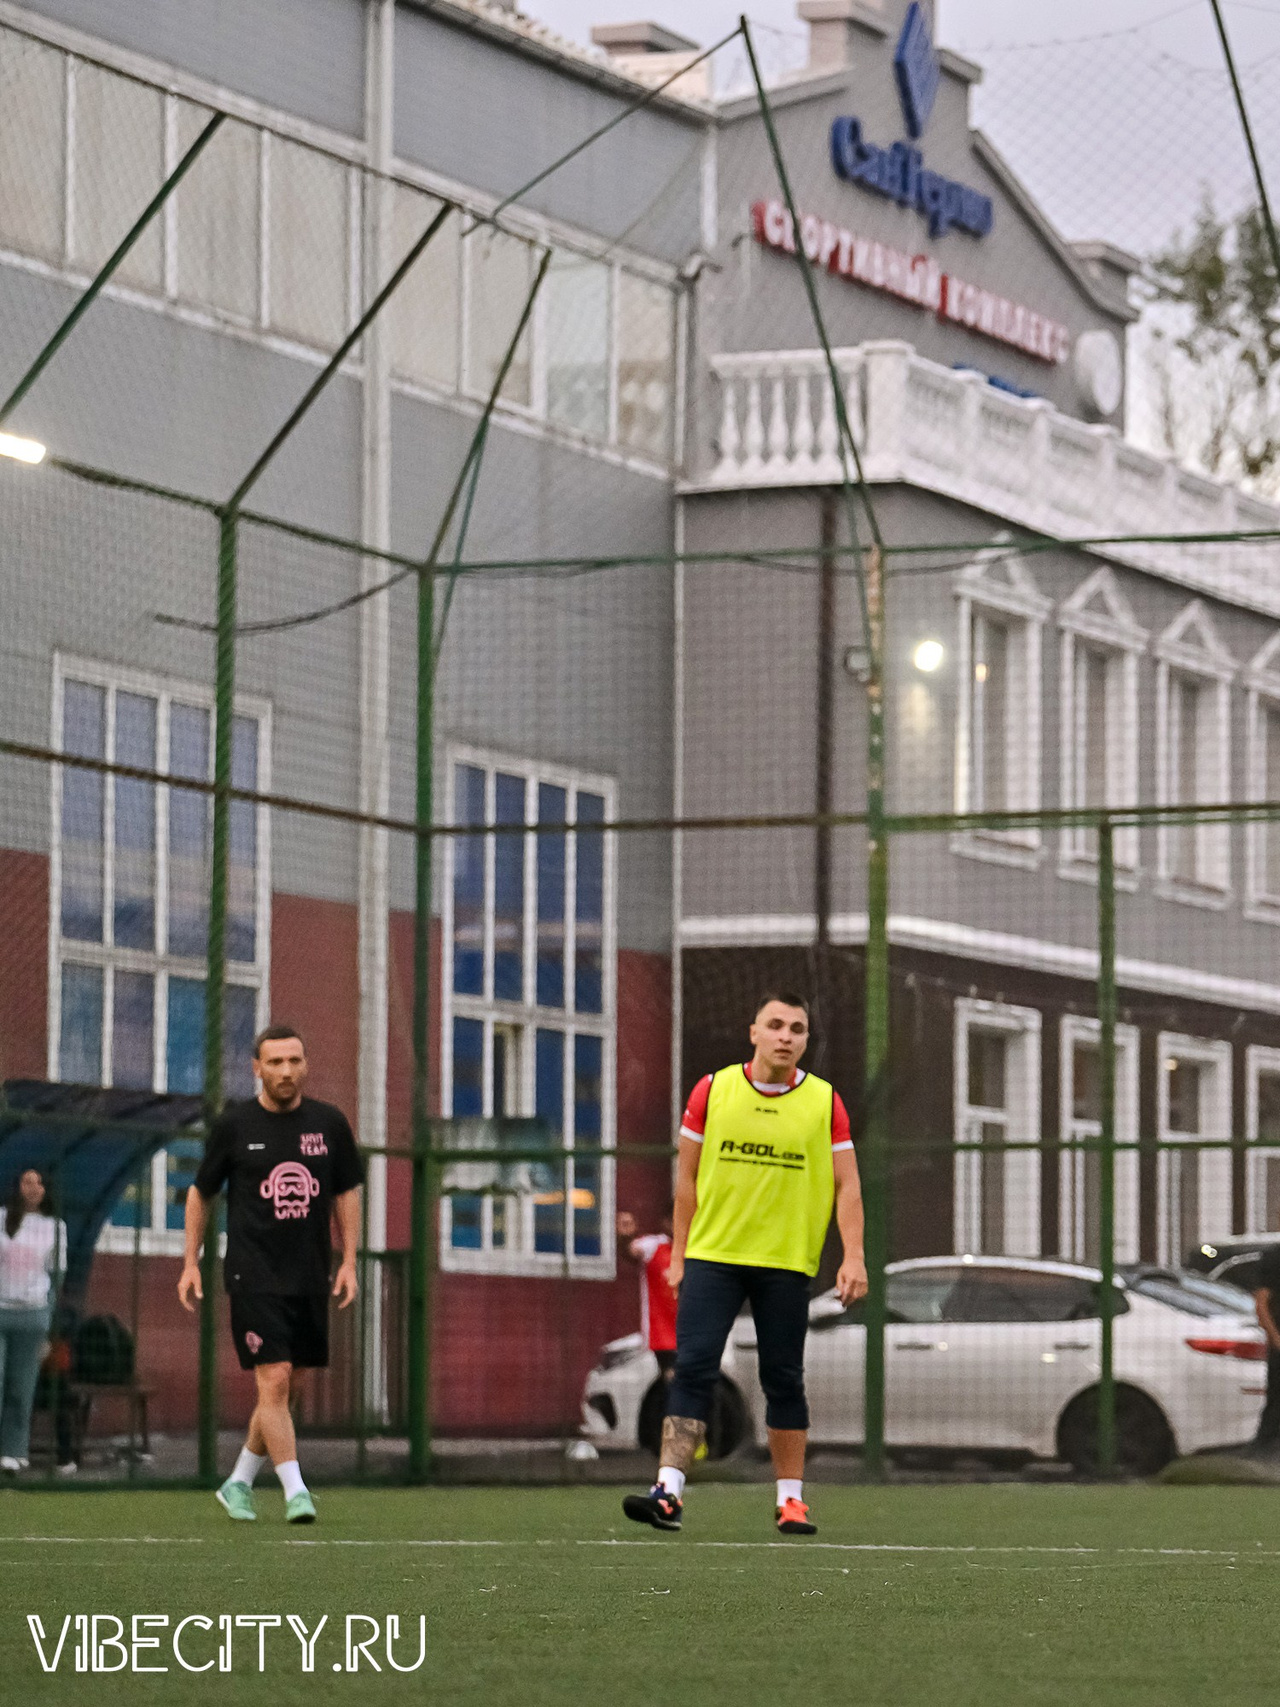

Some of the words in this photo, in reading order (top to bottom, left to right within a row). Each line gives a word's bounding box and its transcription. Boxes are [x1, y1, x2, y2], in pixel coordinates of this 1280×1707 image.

[938, 273, 1071, 364] КОМПЛЕКС
[300, 1143, 329, 1156] TEAM
[274, 1206, 310, 1220] UNIT
